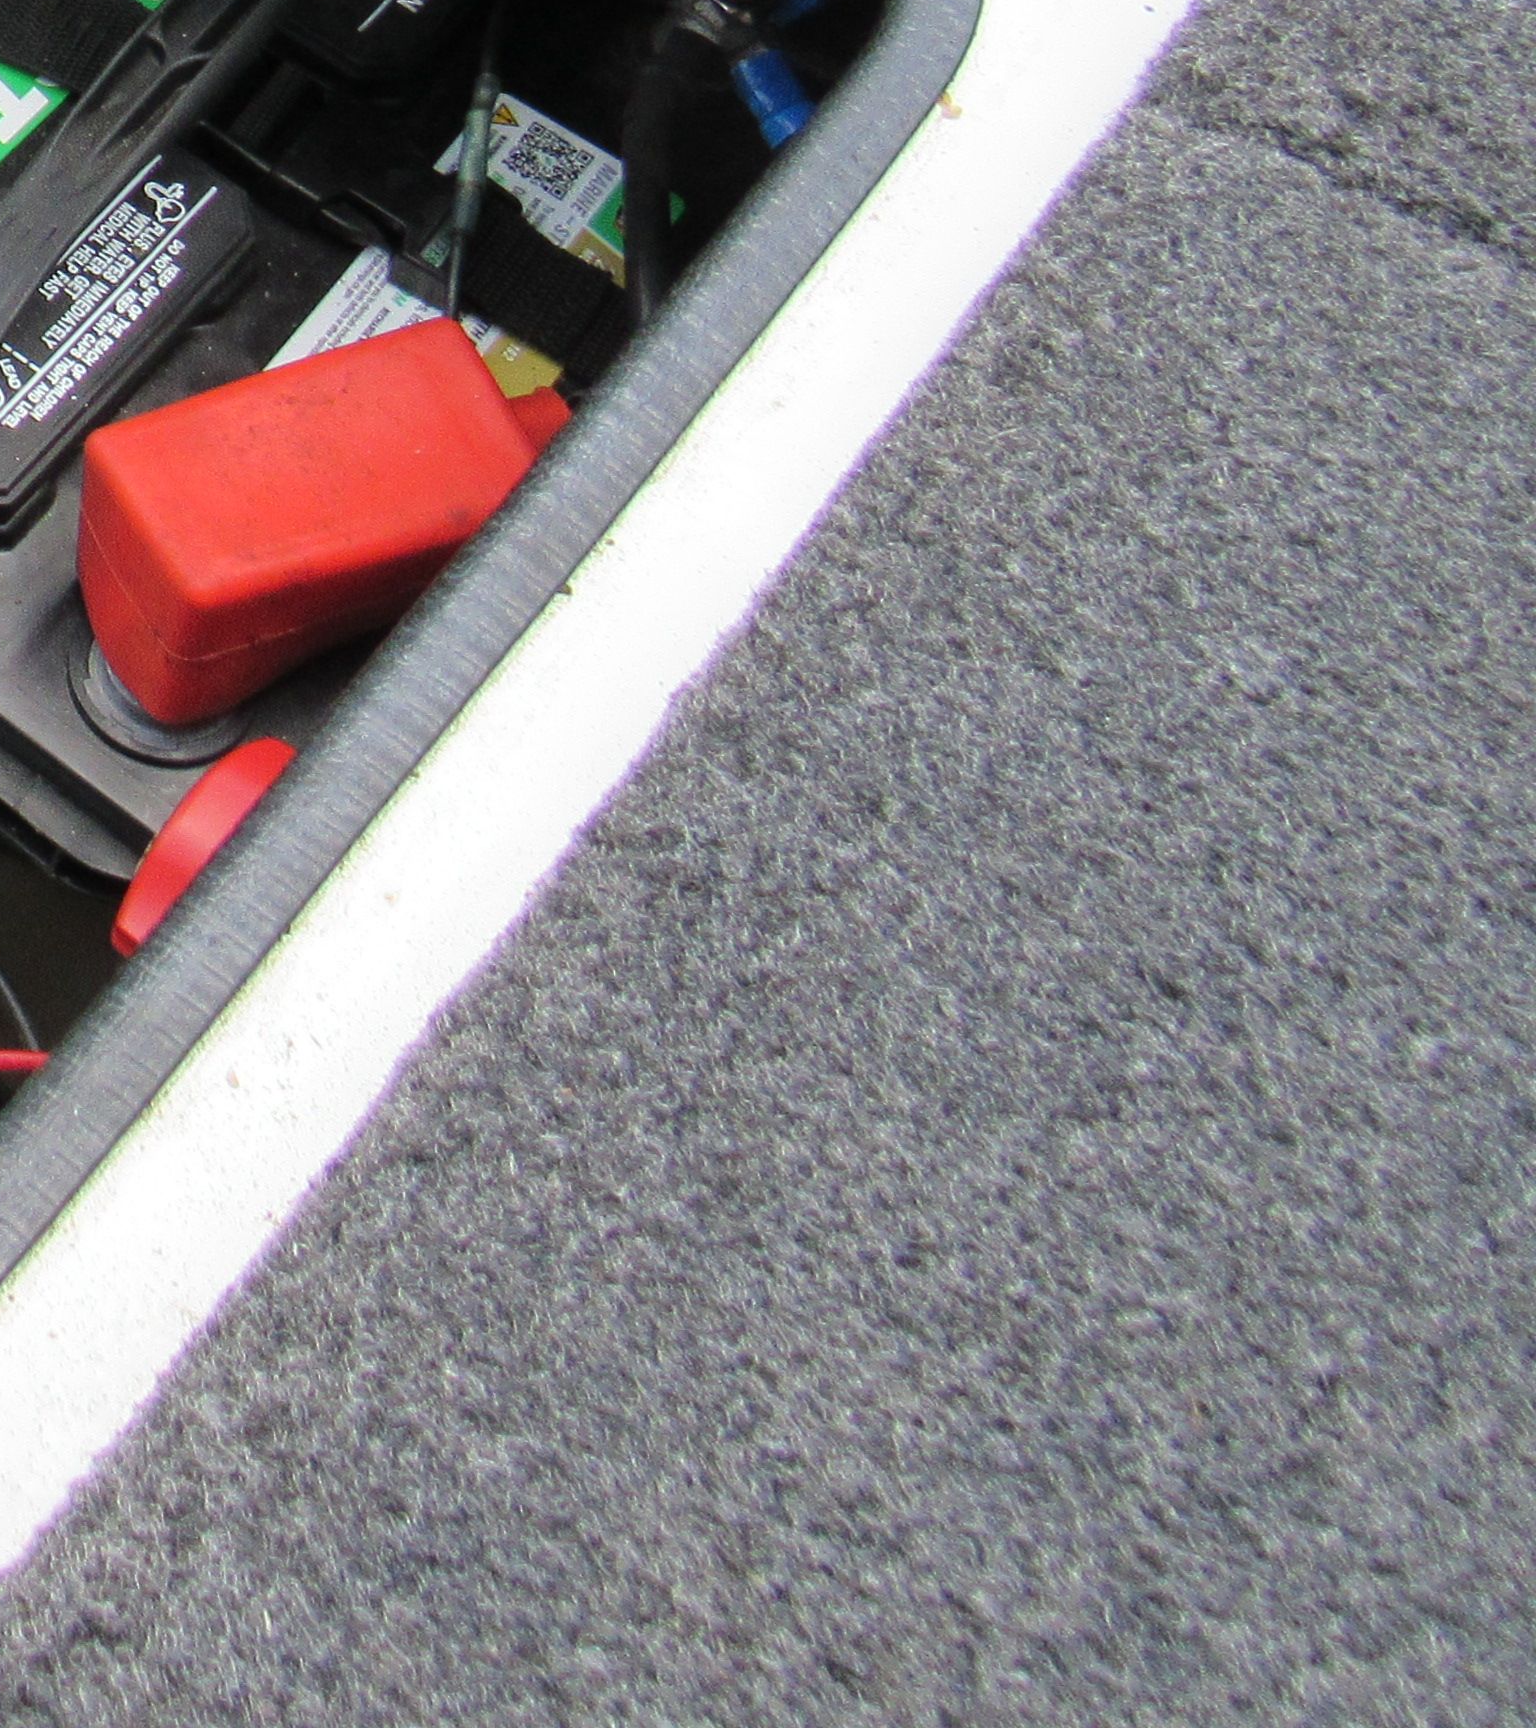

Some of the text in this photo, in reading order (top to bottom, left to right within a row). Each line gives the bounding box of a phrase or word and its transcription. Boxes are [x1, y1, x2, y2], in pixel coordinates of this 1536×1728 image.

[567, 161, 618, 219] MARINE
[37, 199, 136, 302] MEDICAL HELP FAST
[61, 208, 151, 300] WITH WATER. GET
[149, 250, 172, 274] NOT
[165, 237, 184, 256] DO
[38, 219, 165, 350] FLUS EYES IMMEDIATELY
[111, 286, 138, 314] KEEP
[90, 307, 118, 336] VENT
[27, 261, 181, 422] KEEP OUT OF THE REACH OF CHILDREN
[67, 330, 96, 360] CAPS
[42, 354, 74, 386] TIGHT
[25, 380, 50, 405] AND
